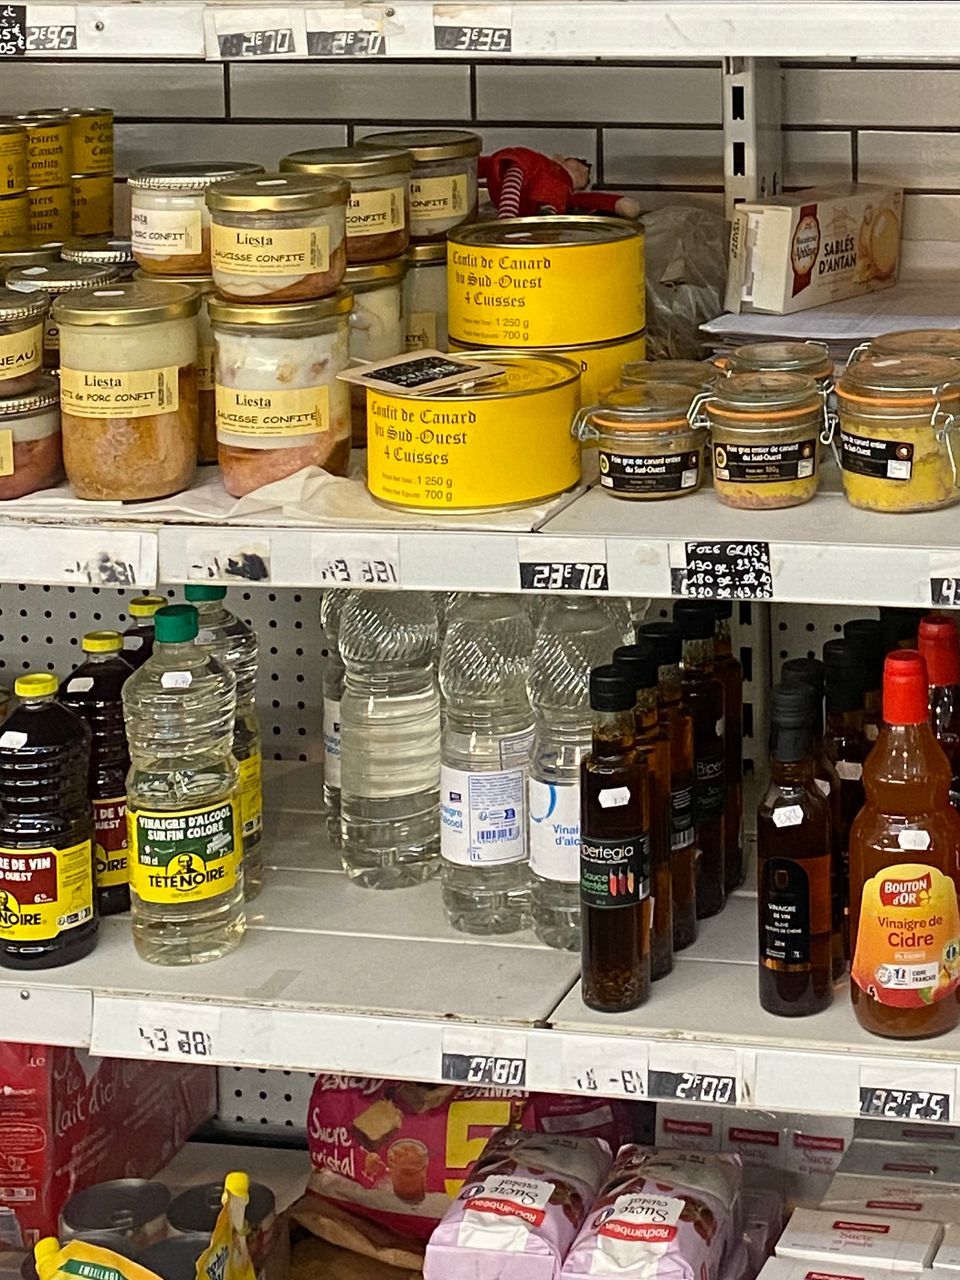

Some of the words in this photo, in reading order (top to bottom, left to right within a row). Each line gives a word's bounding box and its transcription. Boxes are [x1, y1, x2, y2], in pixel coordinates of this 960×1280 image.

[236, 233, 273, 247] Liesta
[824, 238, 854, 258] SABLÉS
[258, 251, 305, 263] CONFITE
[499, 255, 551, 270] Canard
[819, 254, 856, 274] D'ANTAN
[474, 292, 526, 308] Cuisses
[503, 331, 519, 340] 700
[84, 374, 122, 388] Liesta
[86, 392, 112, 402] PORC
[115, 392, 155, 402] CONFIT
[235, 394, 271, 408] Liesta
[263, 411, 317, 424] CONFITE
[419, 408, 476, 425] Canard
[394, 447, 449, 465] Cuisses
[138, 815, 186, 832] VINAIGRE
[189, 806, 231, 826] D'ALCOOL
[147, 827, 183, 841] SURFIN
[187, 820, 224, 837] COLORÉ
[28, 858, 51, 869] VIN
[884, 878, 927, 896] BOUTON
[877, 917, 925, 930] Vinaigre
[929, 916, 943, 927] de
[888, 932, 934, 948] Cidre
